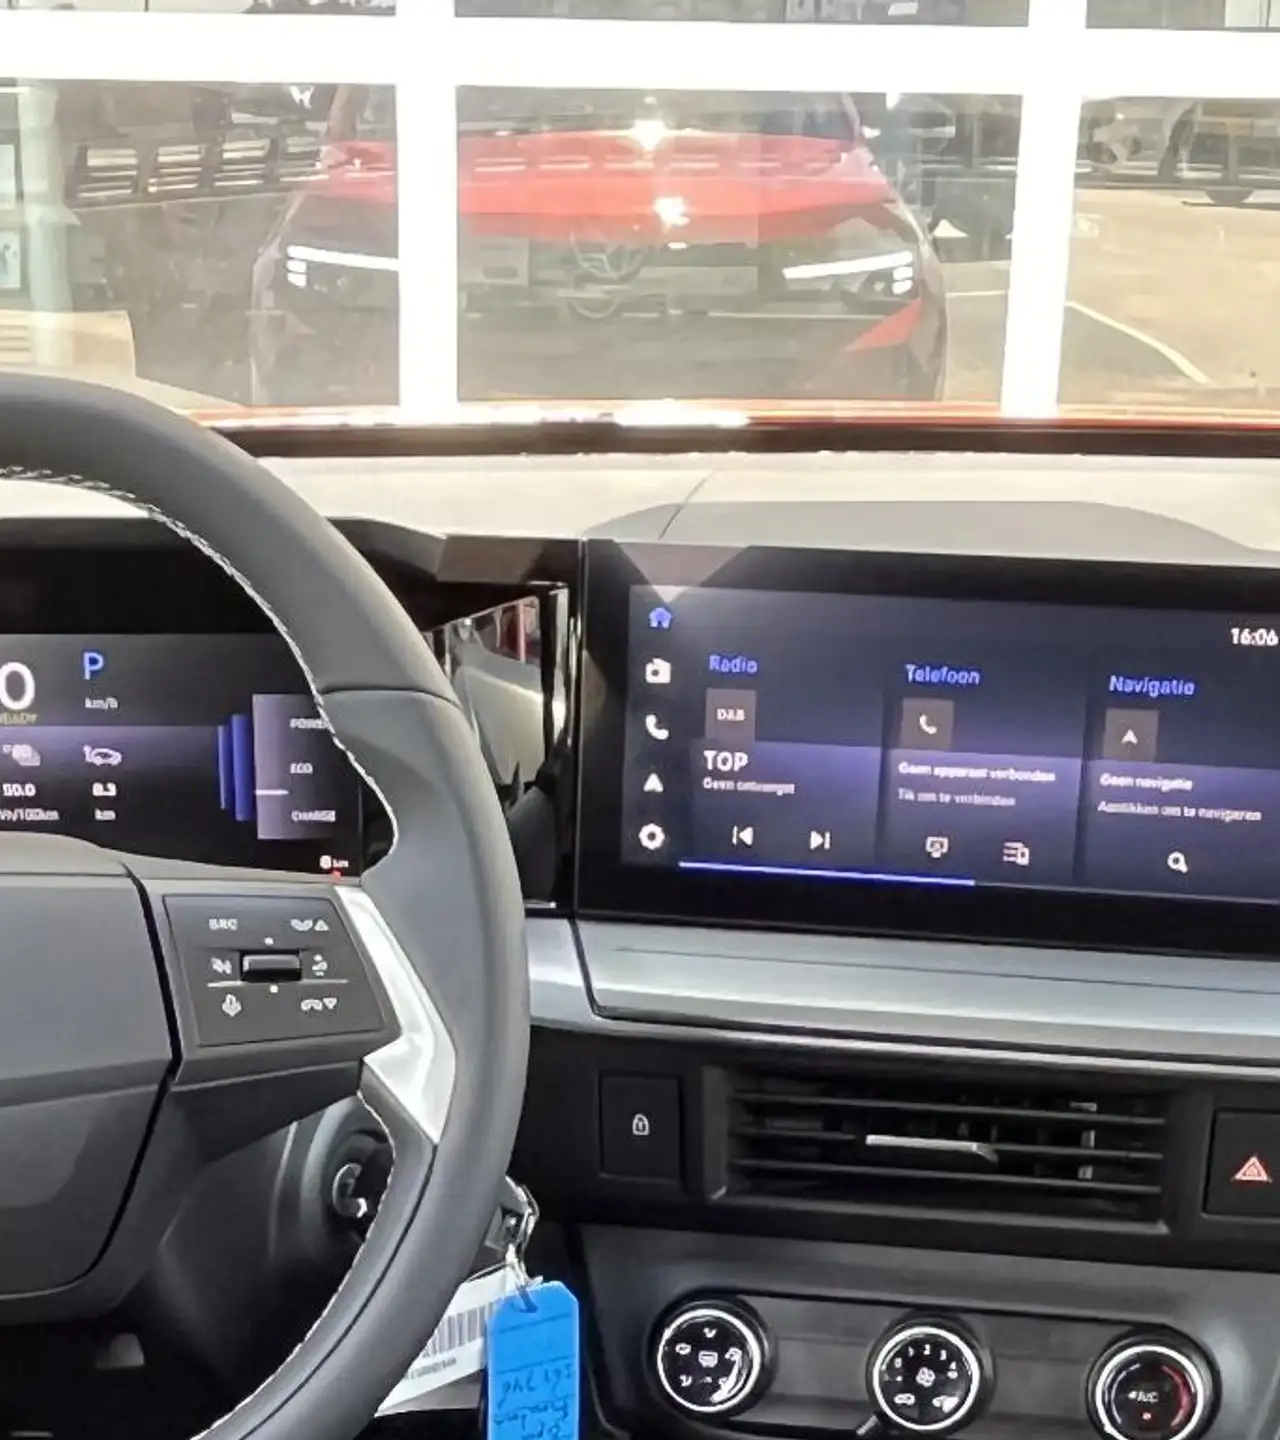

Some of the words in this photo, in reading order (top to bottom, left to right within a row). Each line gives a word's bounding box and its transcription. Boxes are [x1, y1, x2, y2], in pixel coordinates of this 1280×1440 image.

[1230, 627, 1279, 647] 16:06
[83, 652, 105, 680] P
[708, 654, 759, 674] Radio
[905, 664, 981, 685] Telefoon
[1109, 675, 1196, 697] Navigatie
[703, 750, 749, 772] TOP
[1099, 772, 1134, 788] Geen
[1135, 776, 1193, 793] navigatie
